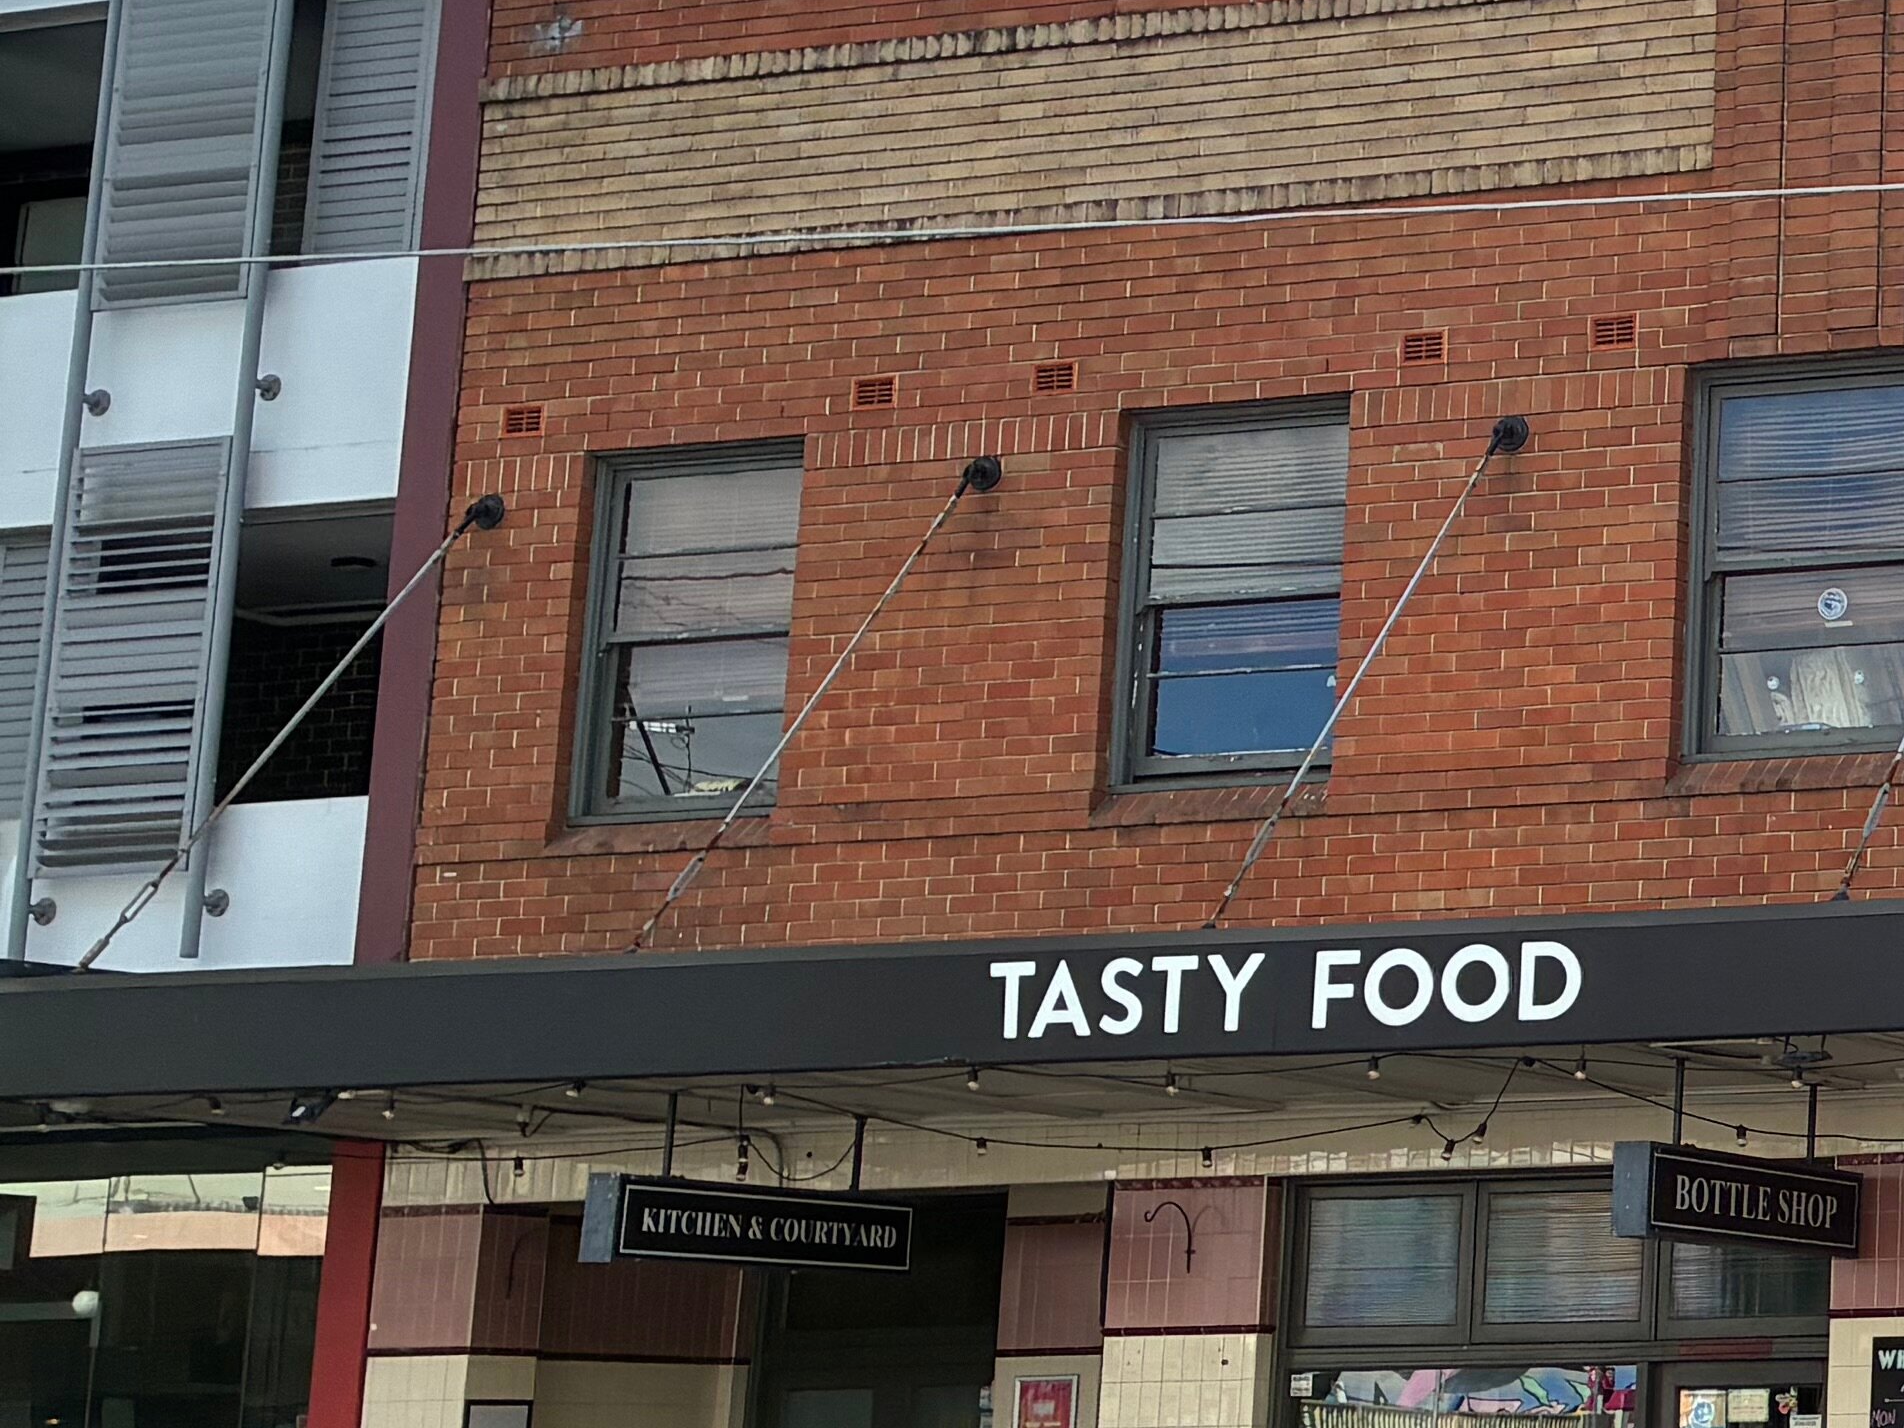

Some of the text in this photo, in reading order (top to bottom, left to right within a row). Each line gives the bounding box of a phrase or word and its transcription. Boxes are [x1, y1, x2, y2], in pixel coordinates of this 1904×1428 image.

[991, 942, 1581, 1038] TASTY FOOD
[641, 1207, 898, 1249] KITCHEN & COURTYARD
[1676, 1174, 1838, 1228] BOTTLE SHOP
